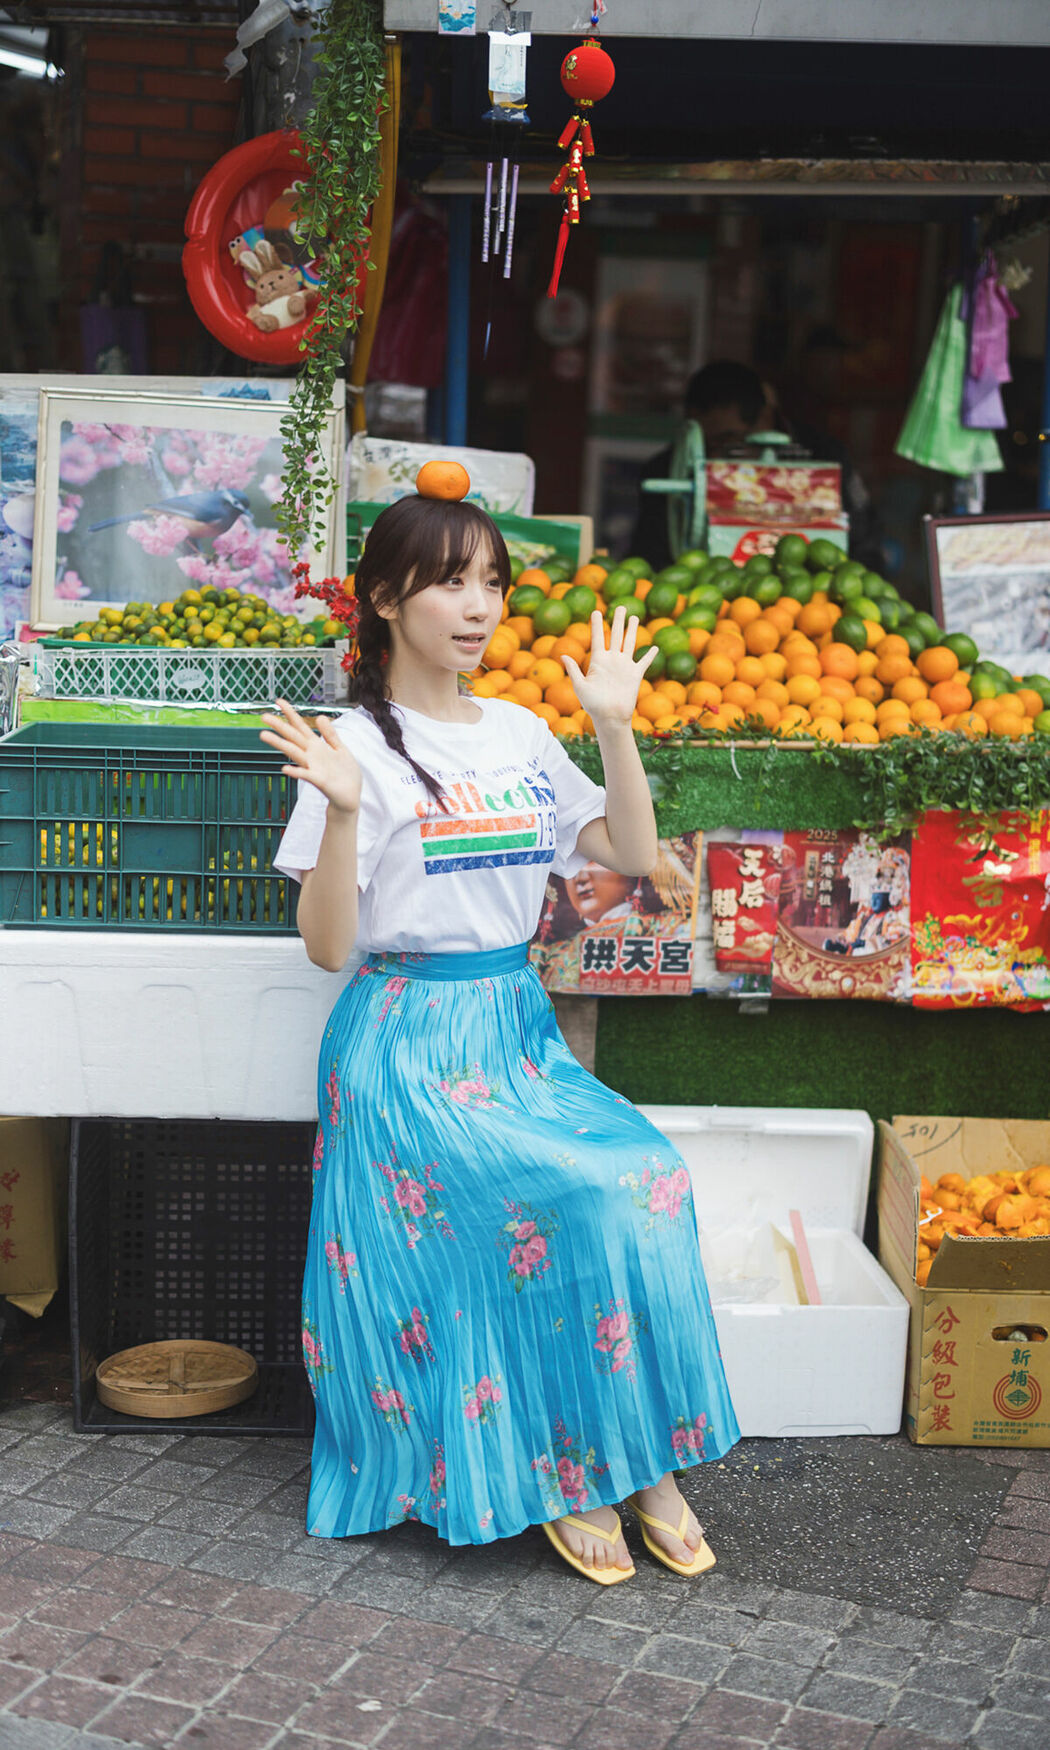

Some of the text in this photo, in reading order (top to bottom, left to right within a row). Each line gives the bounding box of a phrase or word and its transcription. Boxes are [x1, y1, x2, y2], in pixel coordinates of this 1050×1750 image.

[806, 828, 838, 841] 2025
[738, 848, 766, 908] 天后
[819, 851, 836, 907] 北港媽祖
[581, 937, 693, 973] 拱天宮
[930, 1305, 961, 1432] 分級包裝
[1009, 1348, 1032, 1387] 新埔
